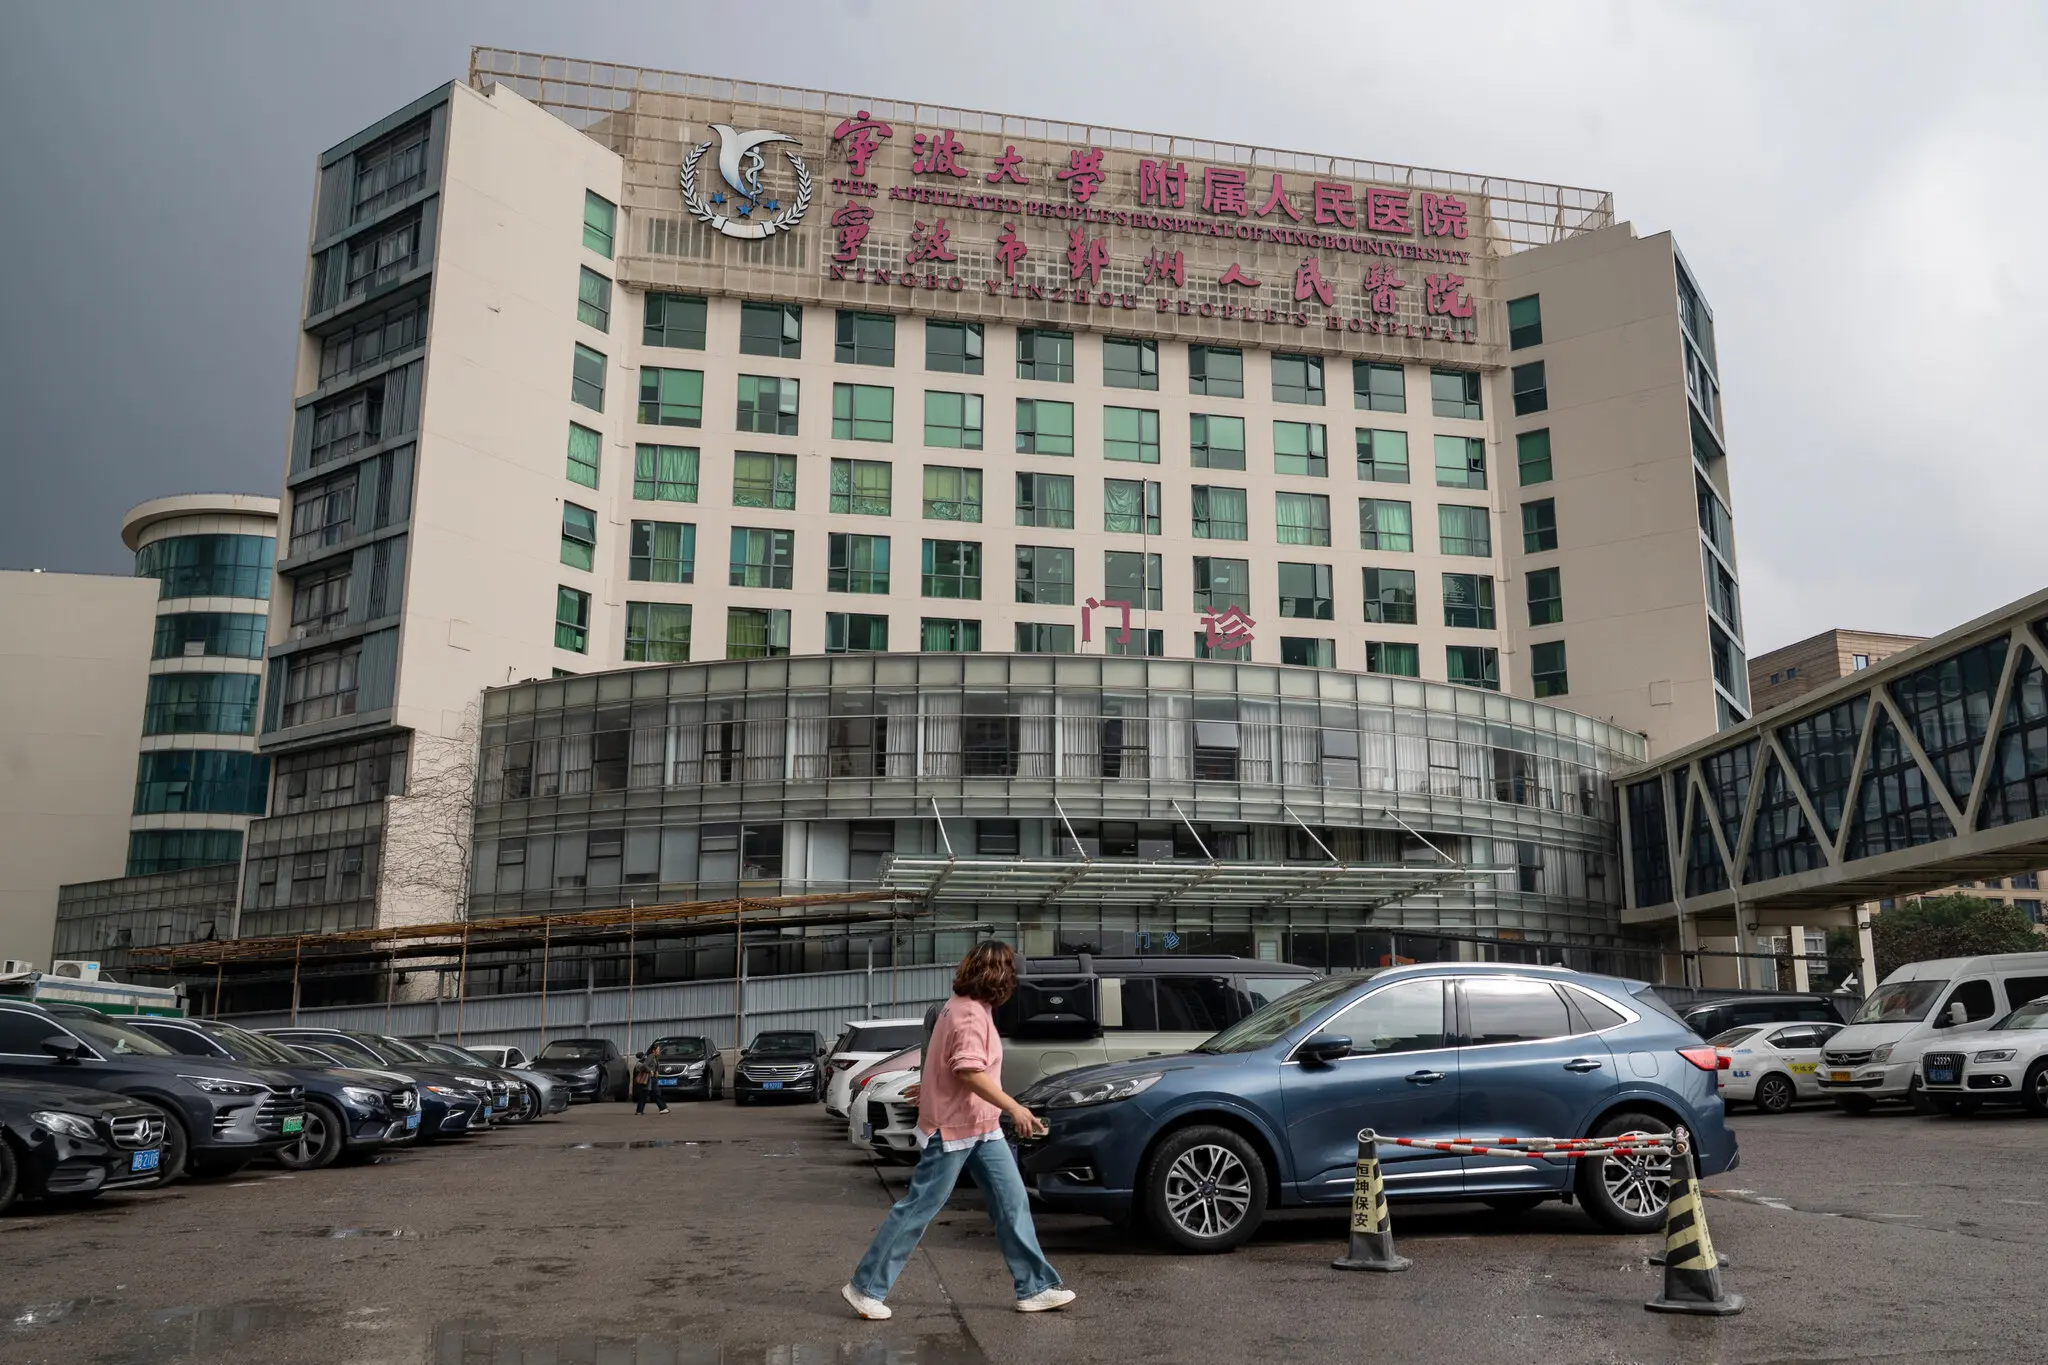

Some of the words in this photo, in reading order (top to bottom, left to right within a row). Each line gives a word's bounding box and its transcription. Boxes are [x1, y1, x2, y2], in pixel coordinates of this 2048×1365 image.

[832, 178, 879, 199] THE
[889, 184, 1022, 214] AFFILIATED
[1027, 200, 1128, 227] PEOPLE'S
[1131, 213, 1235, 239] HOSPITAL
[1237, 224, 1262, 242] OF
[1350, 237, 1471, 266] UNIVERSITY
[830, 263, 964, 292] NINGBO
[986, 278, 1137, 310] YINZHOU
[1156, 297, 1309, 328] PEOPLE'S
[1326, 315, 1477, 345] HOSPITAL
[1082, 597, 1257, 651] 门诊
[1135, 931, 1179, 950] 门诊
[1355, 1163, 1369, 1227] 恒坤保安
